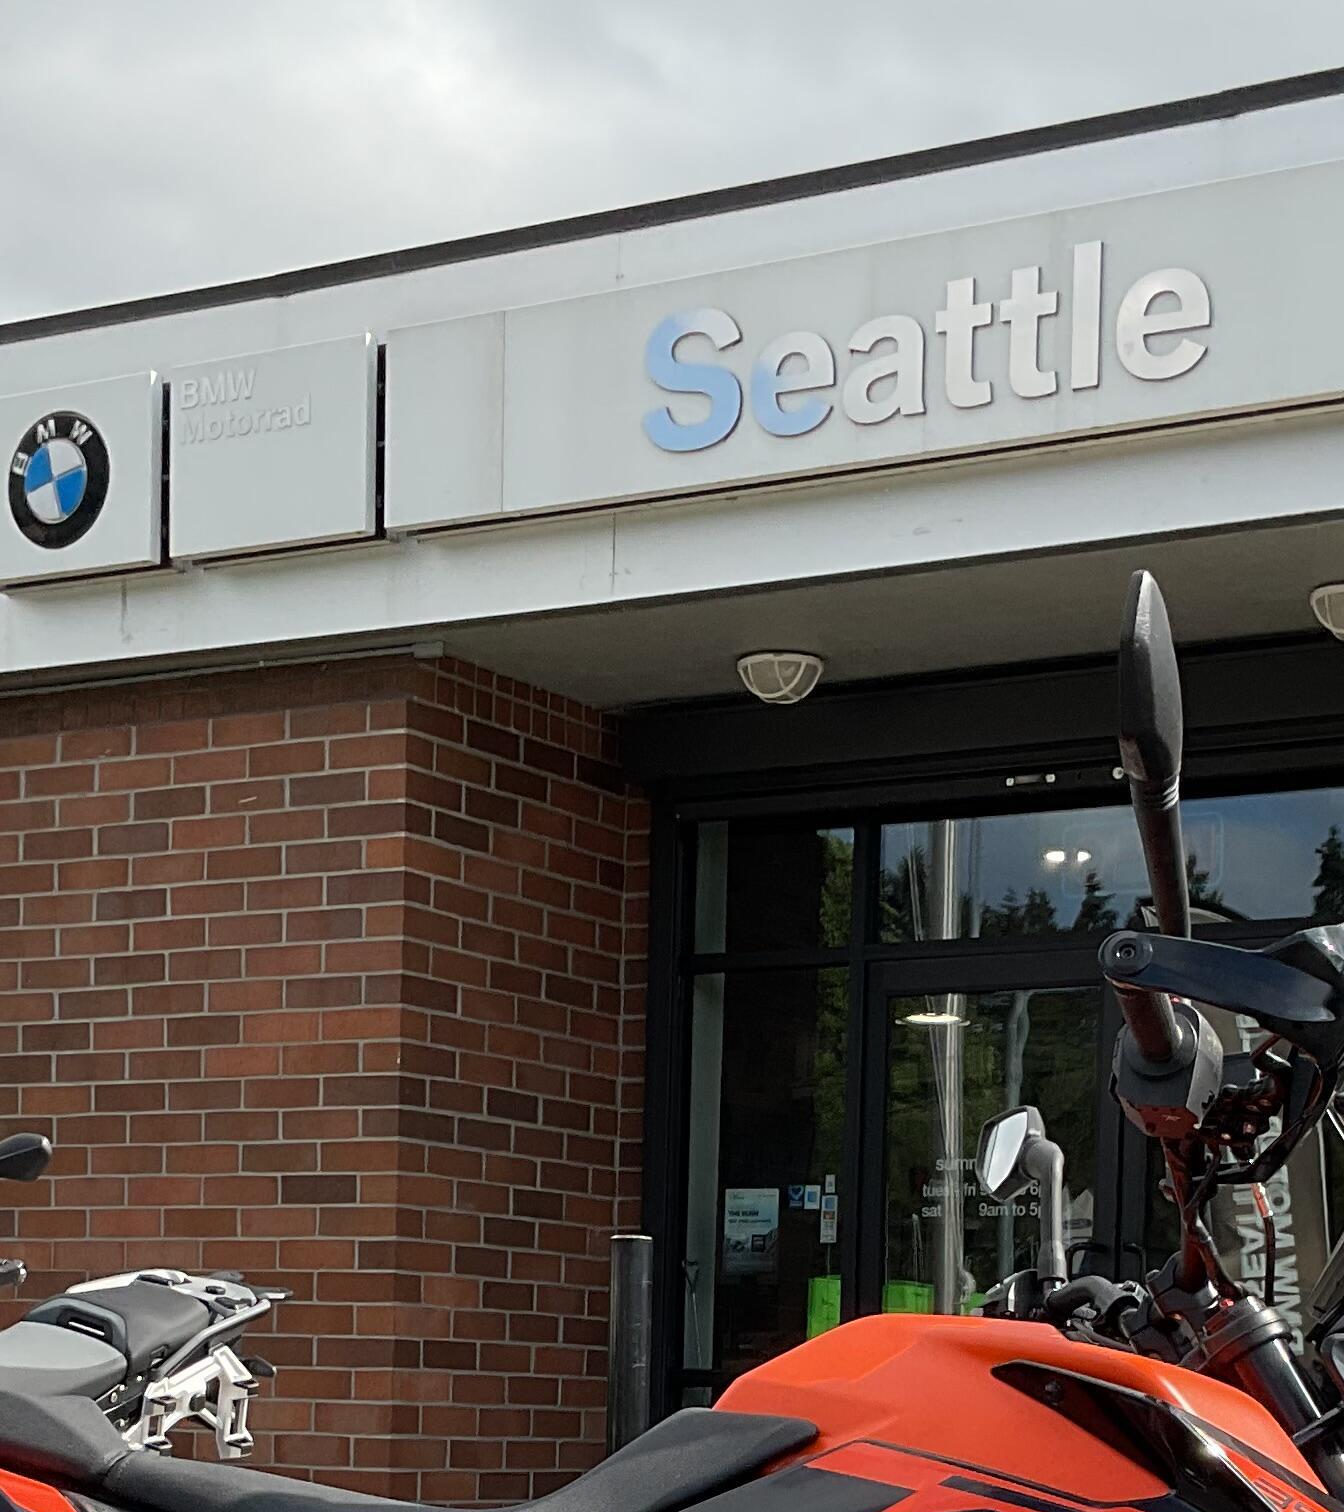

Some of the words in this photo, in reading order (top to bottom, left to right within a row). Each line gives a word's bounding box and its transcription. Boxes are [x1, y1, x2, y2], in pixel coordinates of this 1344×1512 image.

[642, 240, 1212, 452] Seattle
[179, 368, 258, 411] BMW
[11, 418, 94, 476] BMW
[179, 391, 312, 447] Motorrad
[921, 1204, 942, 1217] sat
[978, 1202, 1008, 1217] 9am
[1012, 1202, 1026, 1217] to
